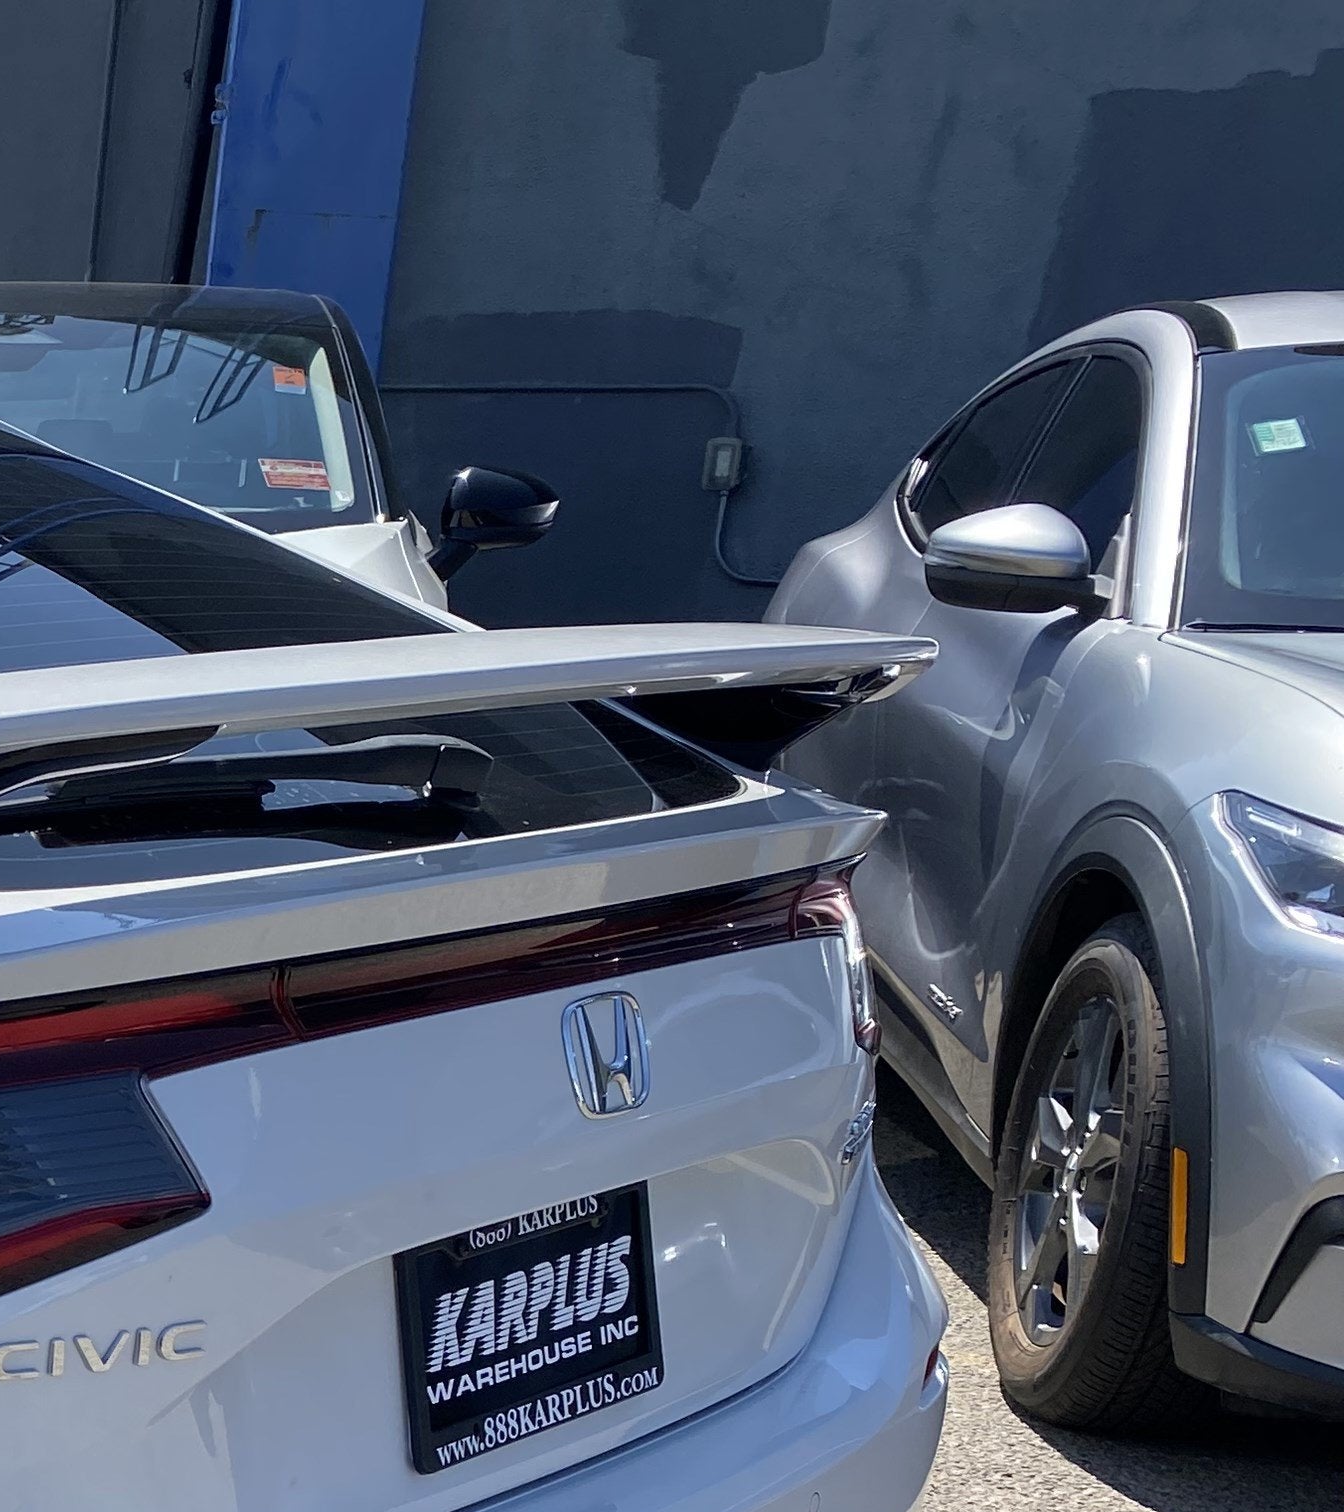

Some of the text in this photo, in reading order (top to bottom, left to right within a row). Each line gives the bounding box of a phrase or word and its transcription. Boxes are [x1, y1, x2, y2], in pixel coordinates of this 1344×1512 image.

[517, 1194, 598, 1236] KARPLUS
[424, 1234, 632, 1373] KARPLUS
[426, 1314, 640, 1405] WAREHOUSE INC
